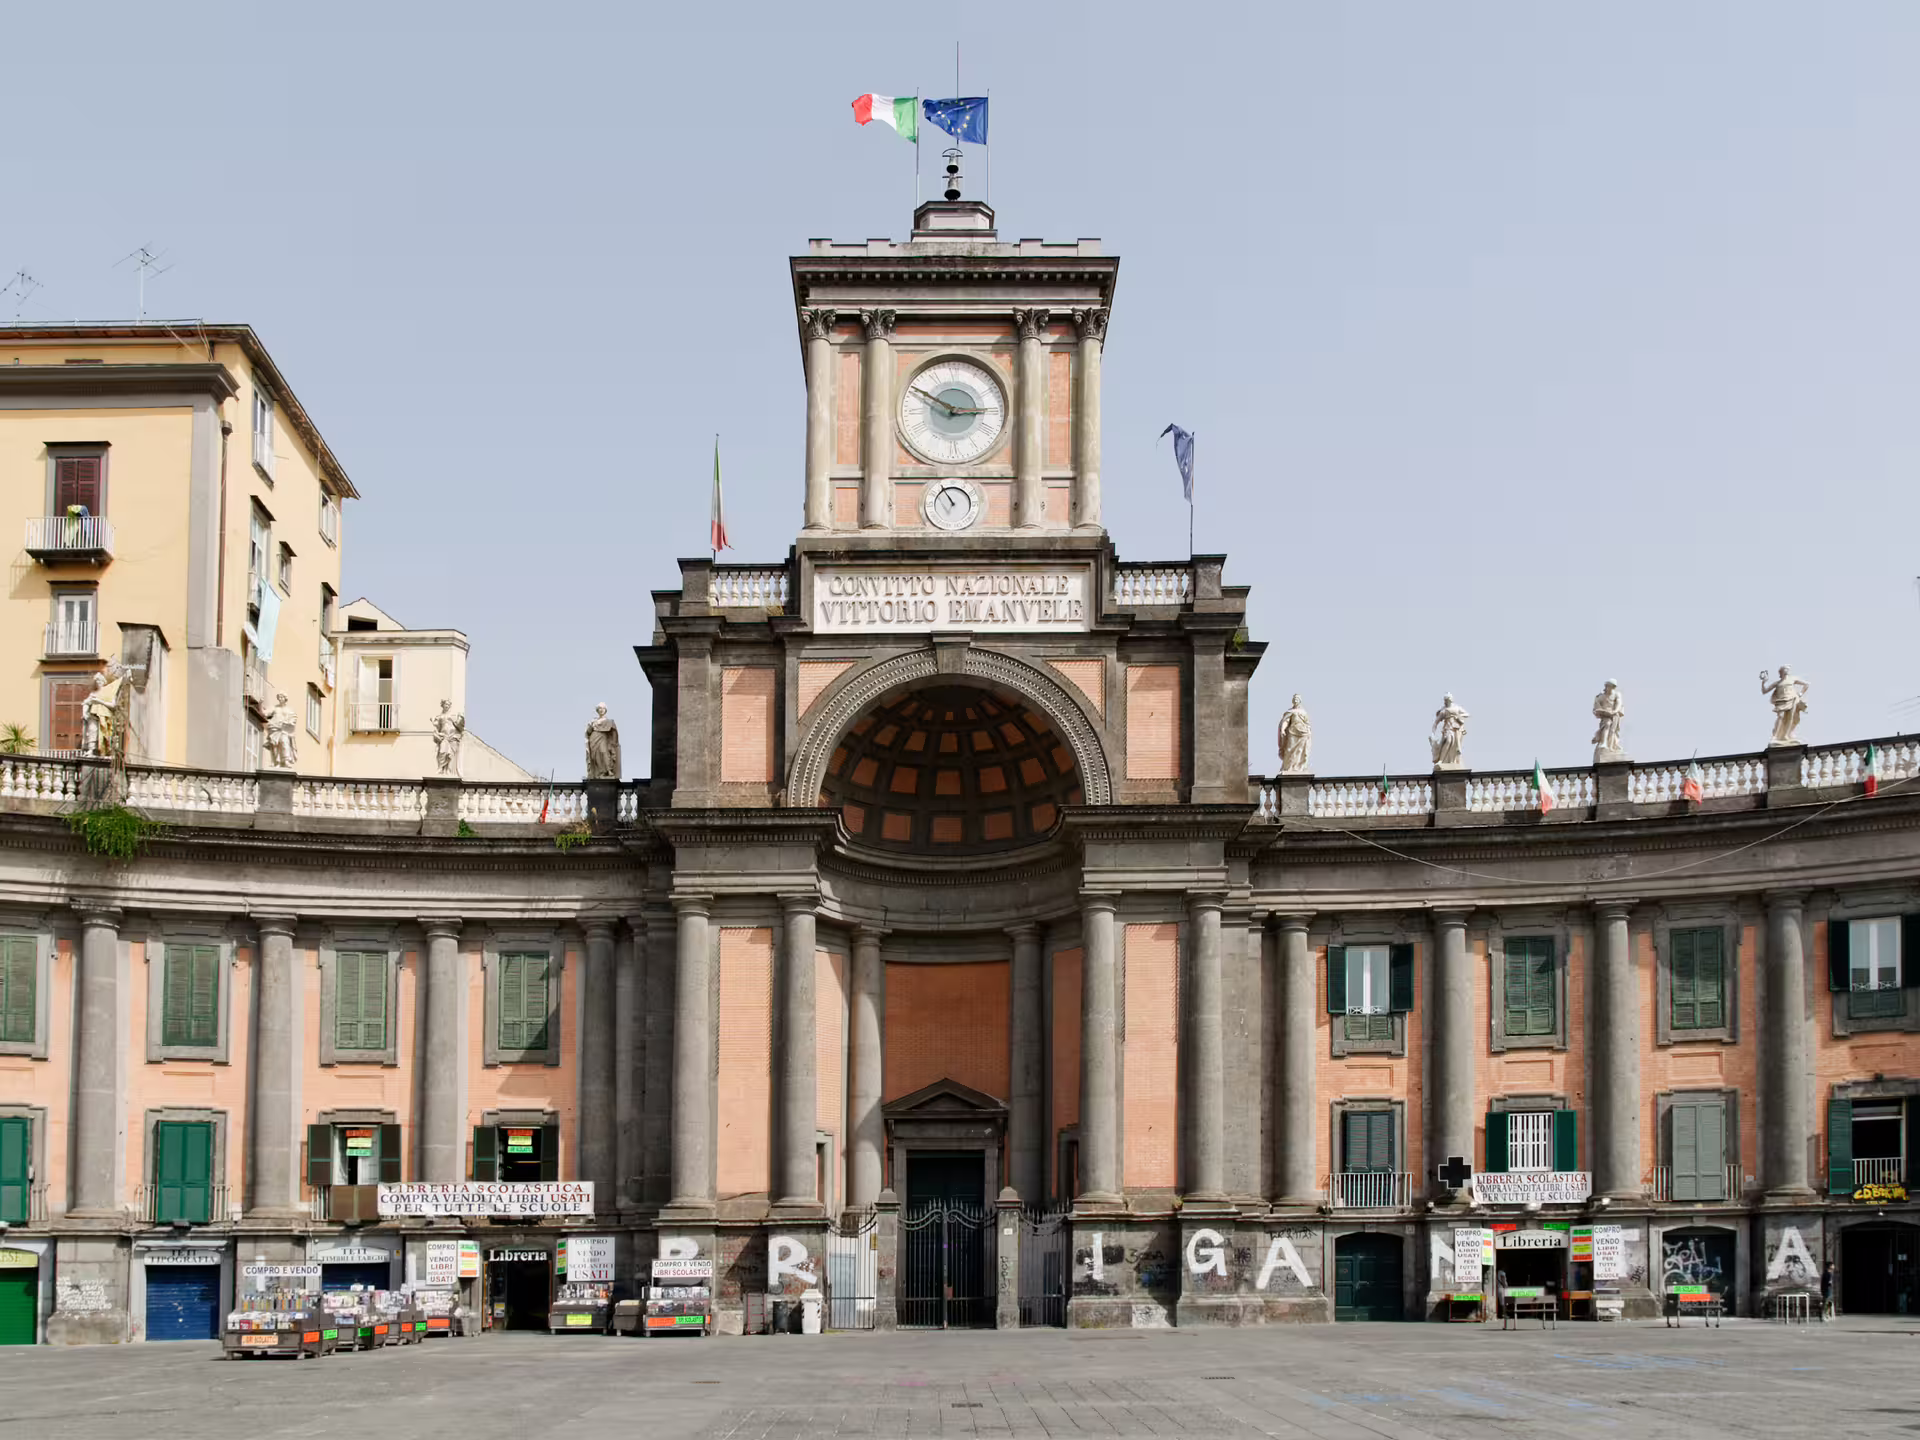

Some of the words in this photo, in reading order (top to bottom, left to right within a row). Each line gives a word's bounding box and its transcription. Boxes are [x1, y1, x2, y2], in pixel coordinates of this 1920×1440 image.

[829, 575, 937, 596] CONVITTO
[945, 575, 1069, 596] NAZIONALE
[821, 600, 938, 624] VITTORIO
[948, 600, 1083, 623] EMANVELE
[1477, 1175, 1523, 1184] LIBRERIA
[1526, 1174, 1588, 1184] SCOLASTICA
[388, 1184, 470, 1194] LIBRERIA
[477, 1183, 583, 1194] SCOLASTICA
[1543, 1183, 1563, 1192] LIBRI
[1565, 1182, 1588, 1191] USATI
[508, 1193, 545, 1203] LIBRI
[550, 1193, 591, 1203] USATI
[1482, 1192, 1499, 1201] PER
[1503, 1192, 1531, 1201] TUTTE
[1535, 1192, 1545, 1201] LE
[1548, 1191, 1581, 1201] SCUOLE
[394, 1203, 423, 1213] PER
[434, 1203, 485, 1213] TUTTE
[493, 1203, 512, 1213] LE
[519, 1203, 582, 1212] SCUOLE
[1594, 1226, 1621, 1234] COMPRO
[1502, 1235, 1562, 1247] Libreria
[428, 1243, 456, 1251] COMPRO
[149, 1256, 216, 1264] TIPOGRAFIA
[489, 1249, 548, 1262] Libreria
[245, 1266, 280, 1275] COMPRO
[283, 1266, 288, 1275] E
[290, 1266, 319, 1275] VENDO
[574, 1270, 609, 1279] USATI
[672, 1268, 710, 1276] SCOLASTICI
[430, 1275, 454, 1283] USATI
